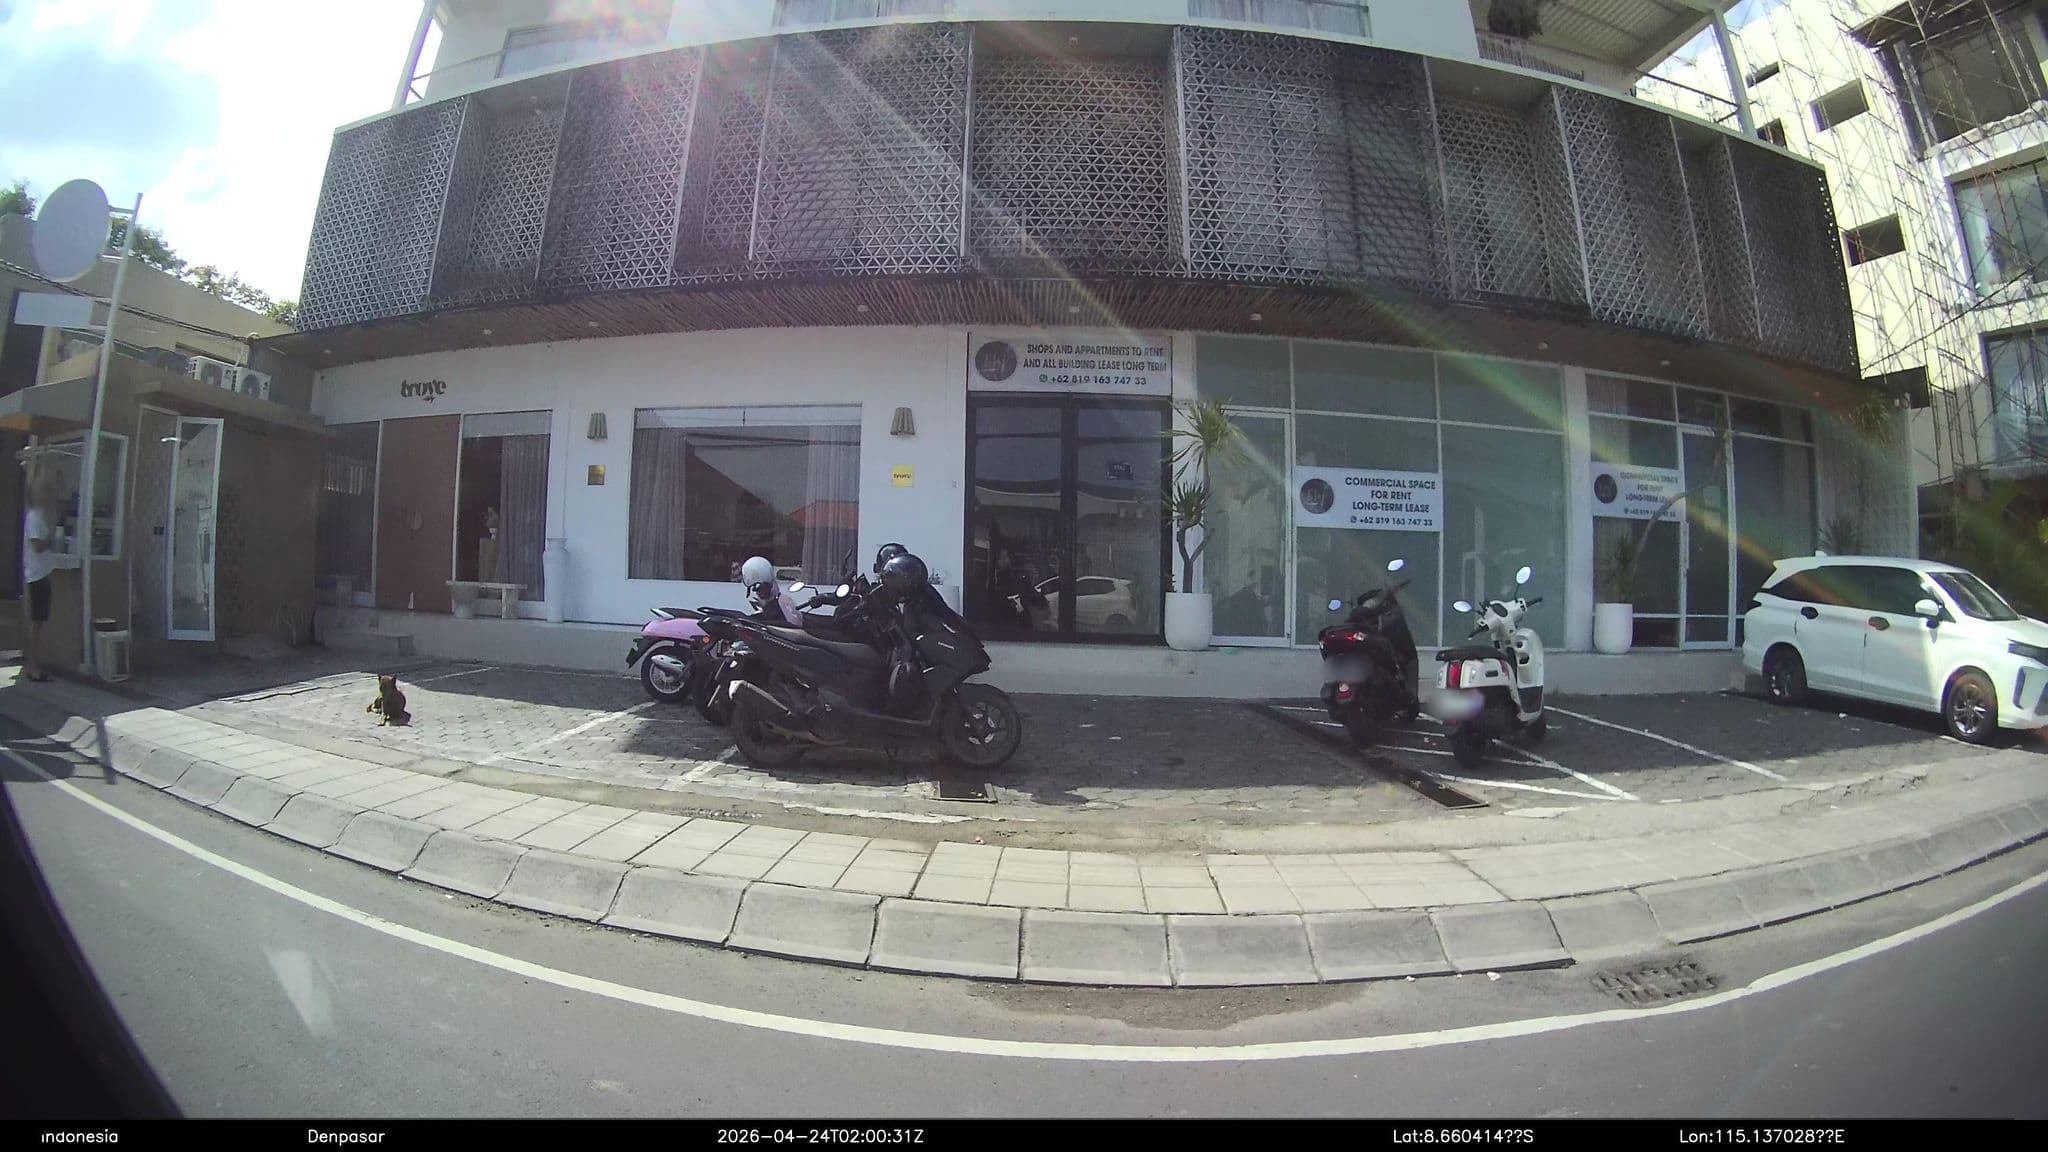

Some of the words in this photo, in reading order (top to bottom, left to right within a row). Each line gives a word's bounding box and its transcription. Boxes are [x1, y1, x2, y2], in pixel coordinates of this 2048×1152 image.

[1027, 344, 1053, 354] SHOPS
[1056, 345, 1073, 354] AND
[1132, 347, 1142, 356] TO
[1144, 347, 1164, 357] RENT
[1023, 359, 1041, 368] AND
[1043, 359, 1056, 369] ALL
[1058, 360, 1096, 369] BUILDING
[1098, 360, 1120, 370] LEASE
[1122, 361, 1145, 371] LONG
[1147, 361, 1167, 371] TERM
[1051, 375, 1069, 383] +62
[1094, 376, 1111, 384] 163
[1114, 376, 1131, 385] 747
[1134, 377, 1147, 385] 33
[1345, 477, 1406, 489] COMMERCIAL
[1408, 480, 1436, 490] SPACE
[1371, 490, 1388, 499] FOR
[1391, 491, 1412, 500] RENT
[1352, 501, 1402, 512] LONG-TERM
[1405, 504, 1430, 513] LEASE
[1360, 516, 1373, 524] +62
